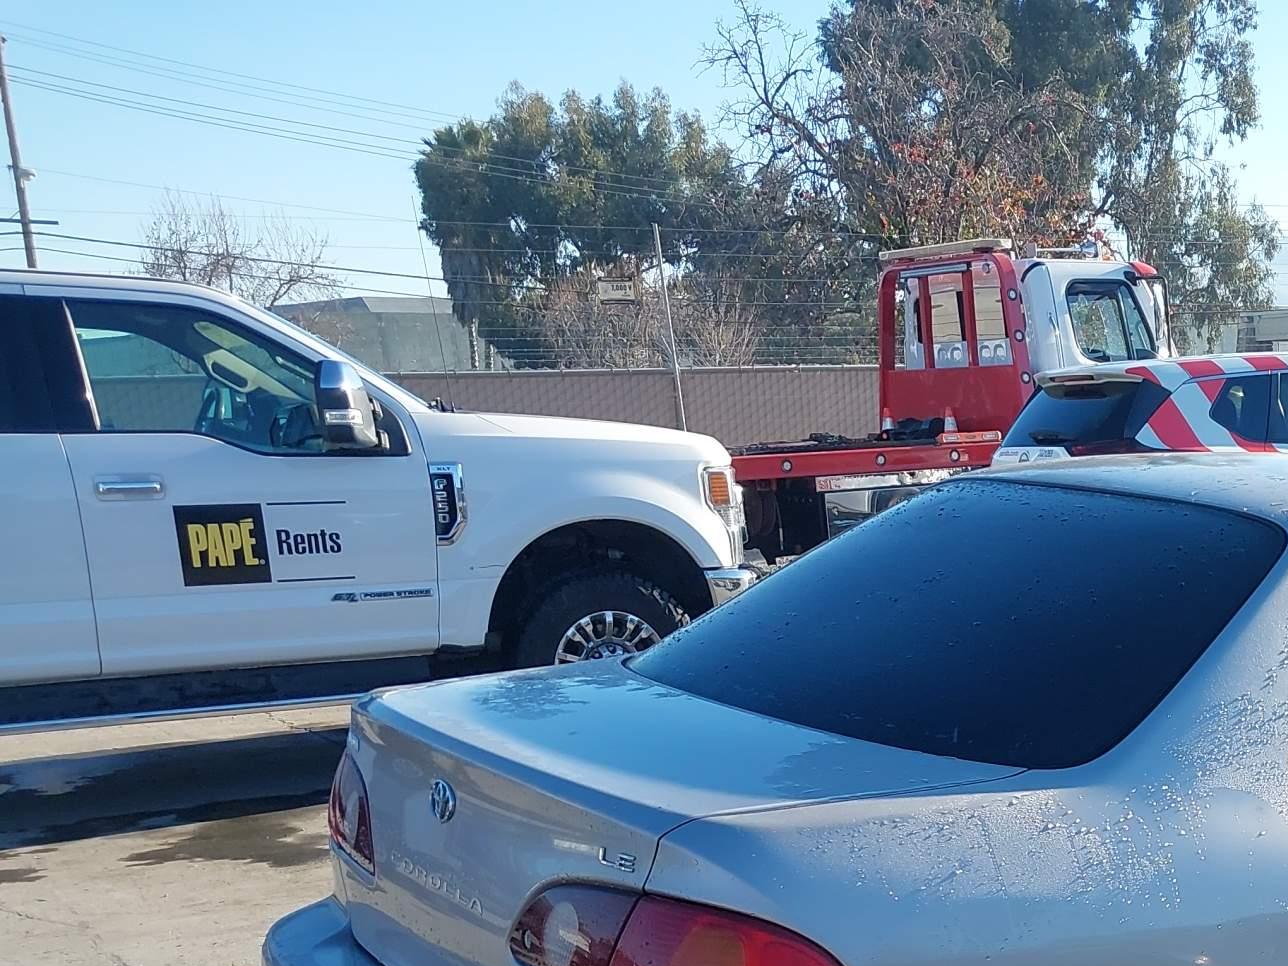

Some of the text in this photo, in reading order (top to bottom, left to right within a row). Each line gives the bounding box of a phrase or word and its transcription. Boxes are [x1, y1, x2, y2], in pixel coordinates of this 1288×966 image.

[276, 529, 342, 555] Rents
[396, 588, 432, 597] STROKE
[598, 847, 637, 872] LE
[390, 852, 484, 914] COROLLA
